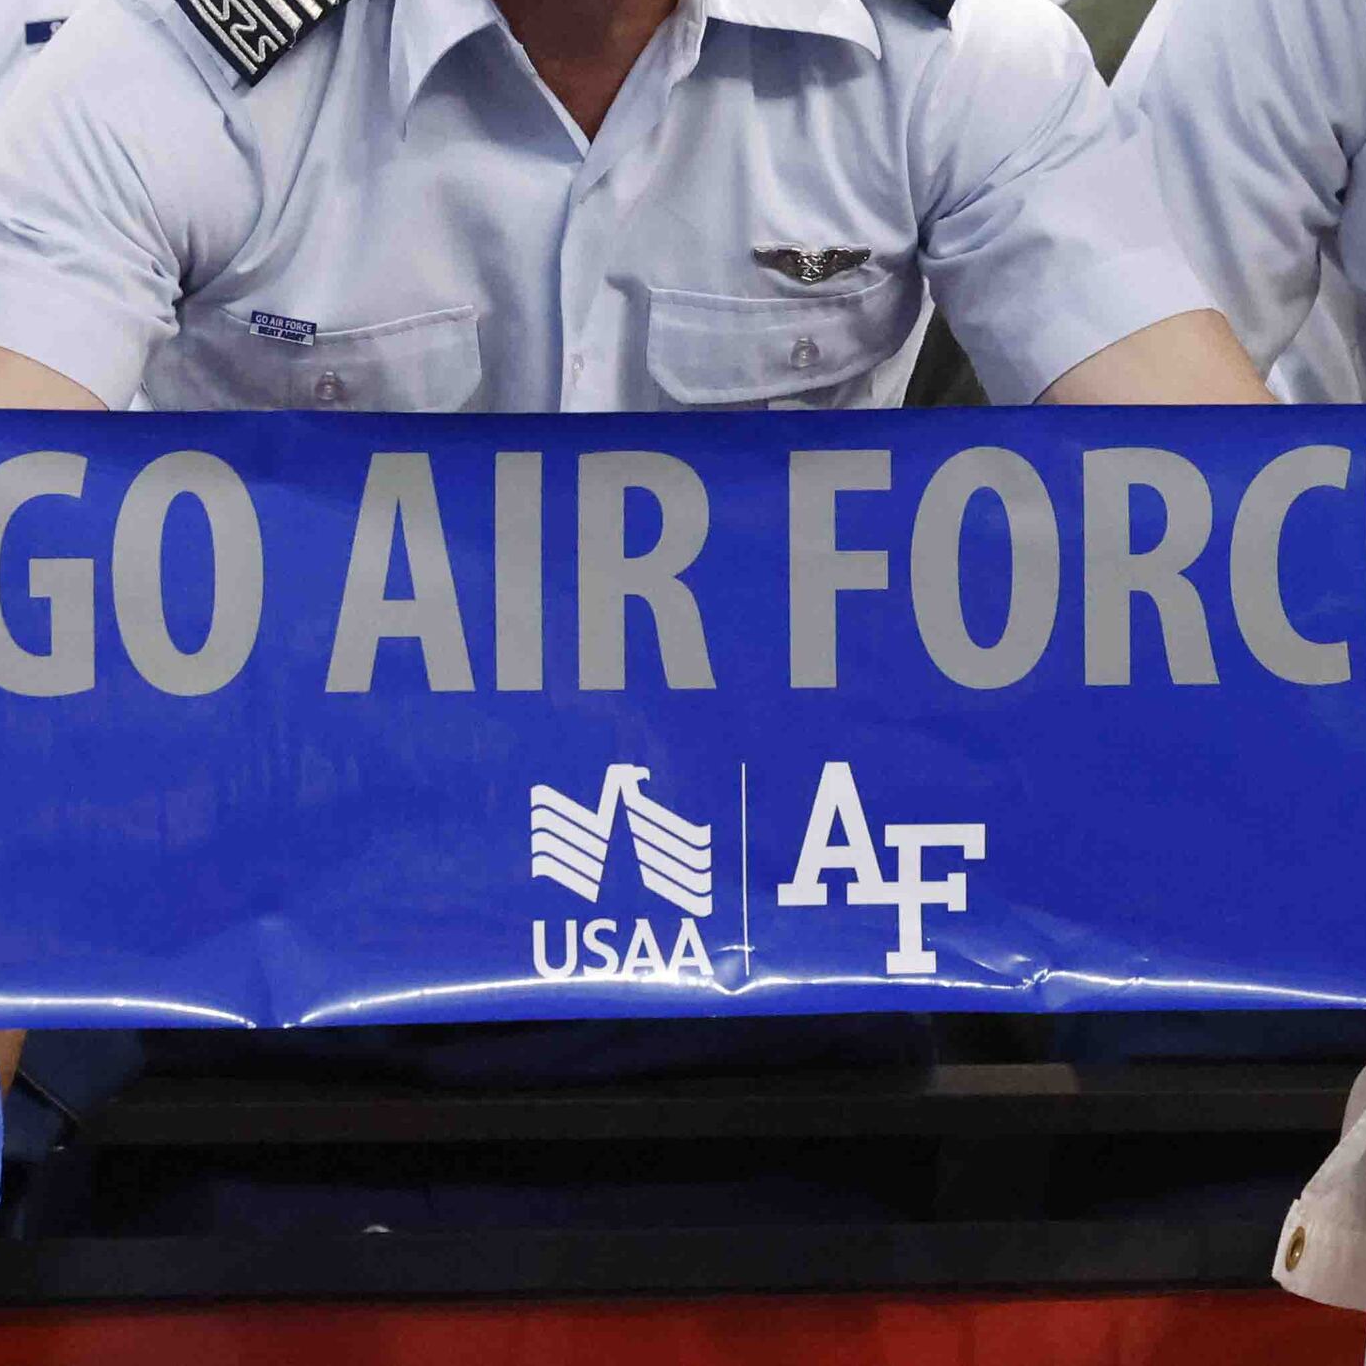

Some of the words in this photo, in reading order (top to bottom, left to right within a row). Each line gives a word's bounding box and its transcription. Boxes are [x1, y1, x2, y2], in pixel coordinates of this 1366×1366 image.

[255, 314, 269, 325] GO
[269, 317, 284, 328] AIR
[284, 319, 313, 333] FORCE
[325, 451, 717, 693] AIR
[776, 761, 986, 975] AF
[531, 918, 714, 980] USAA
